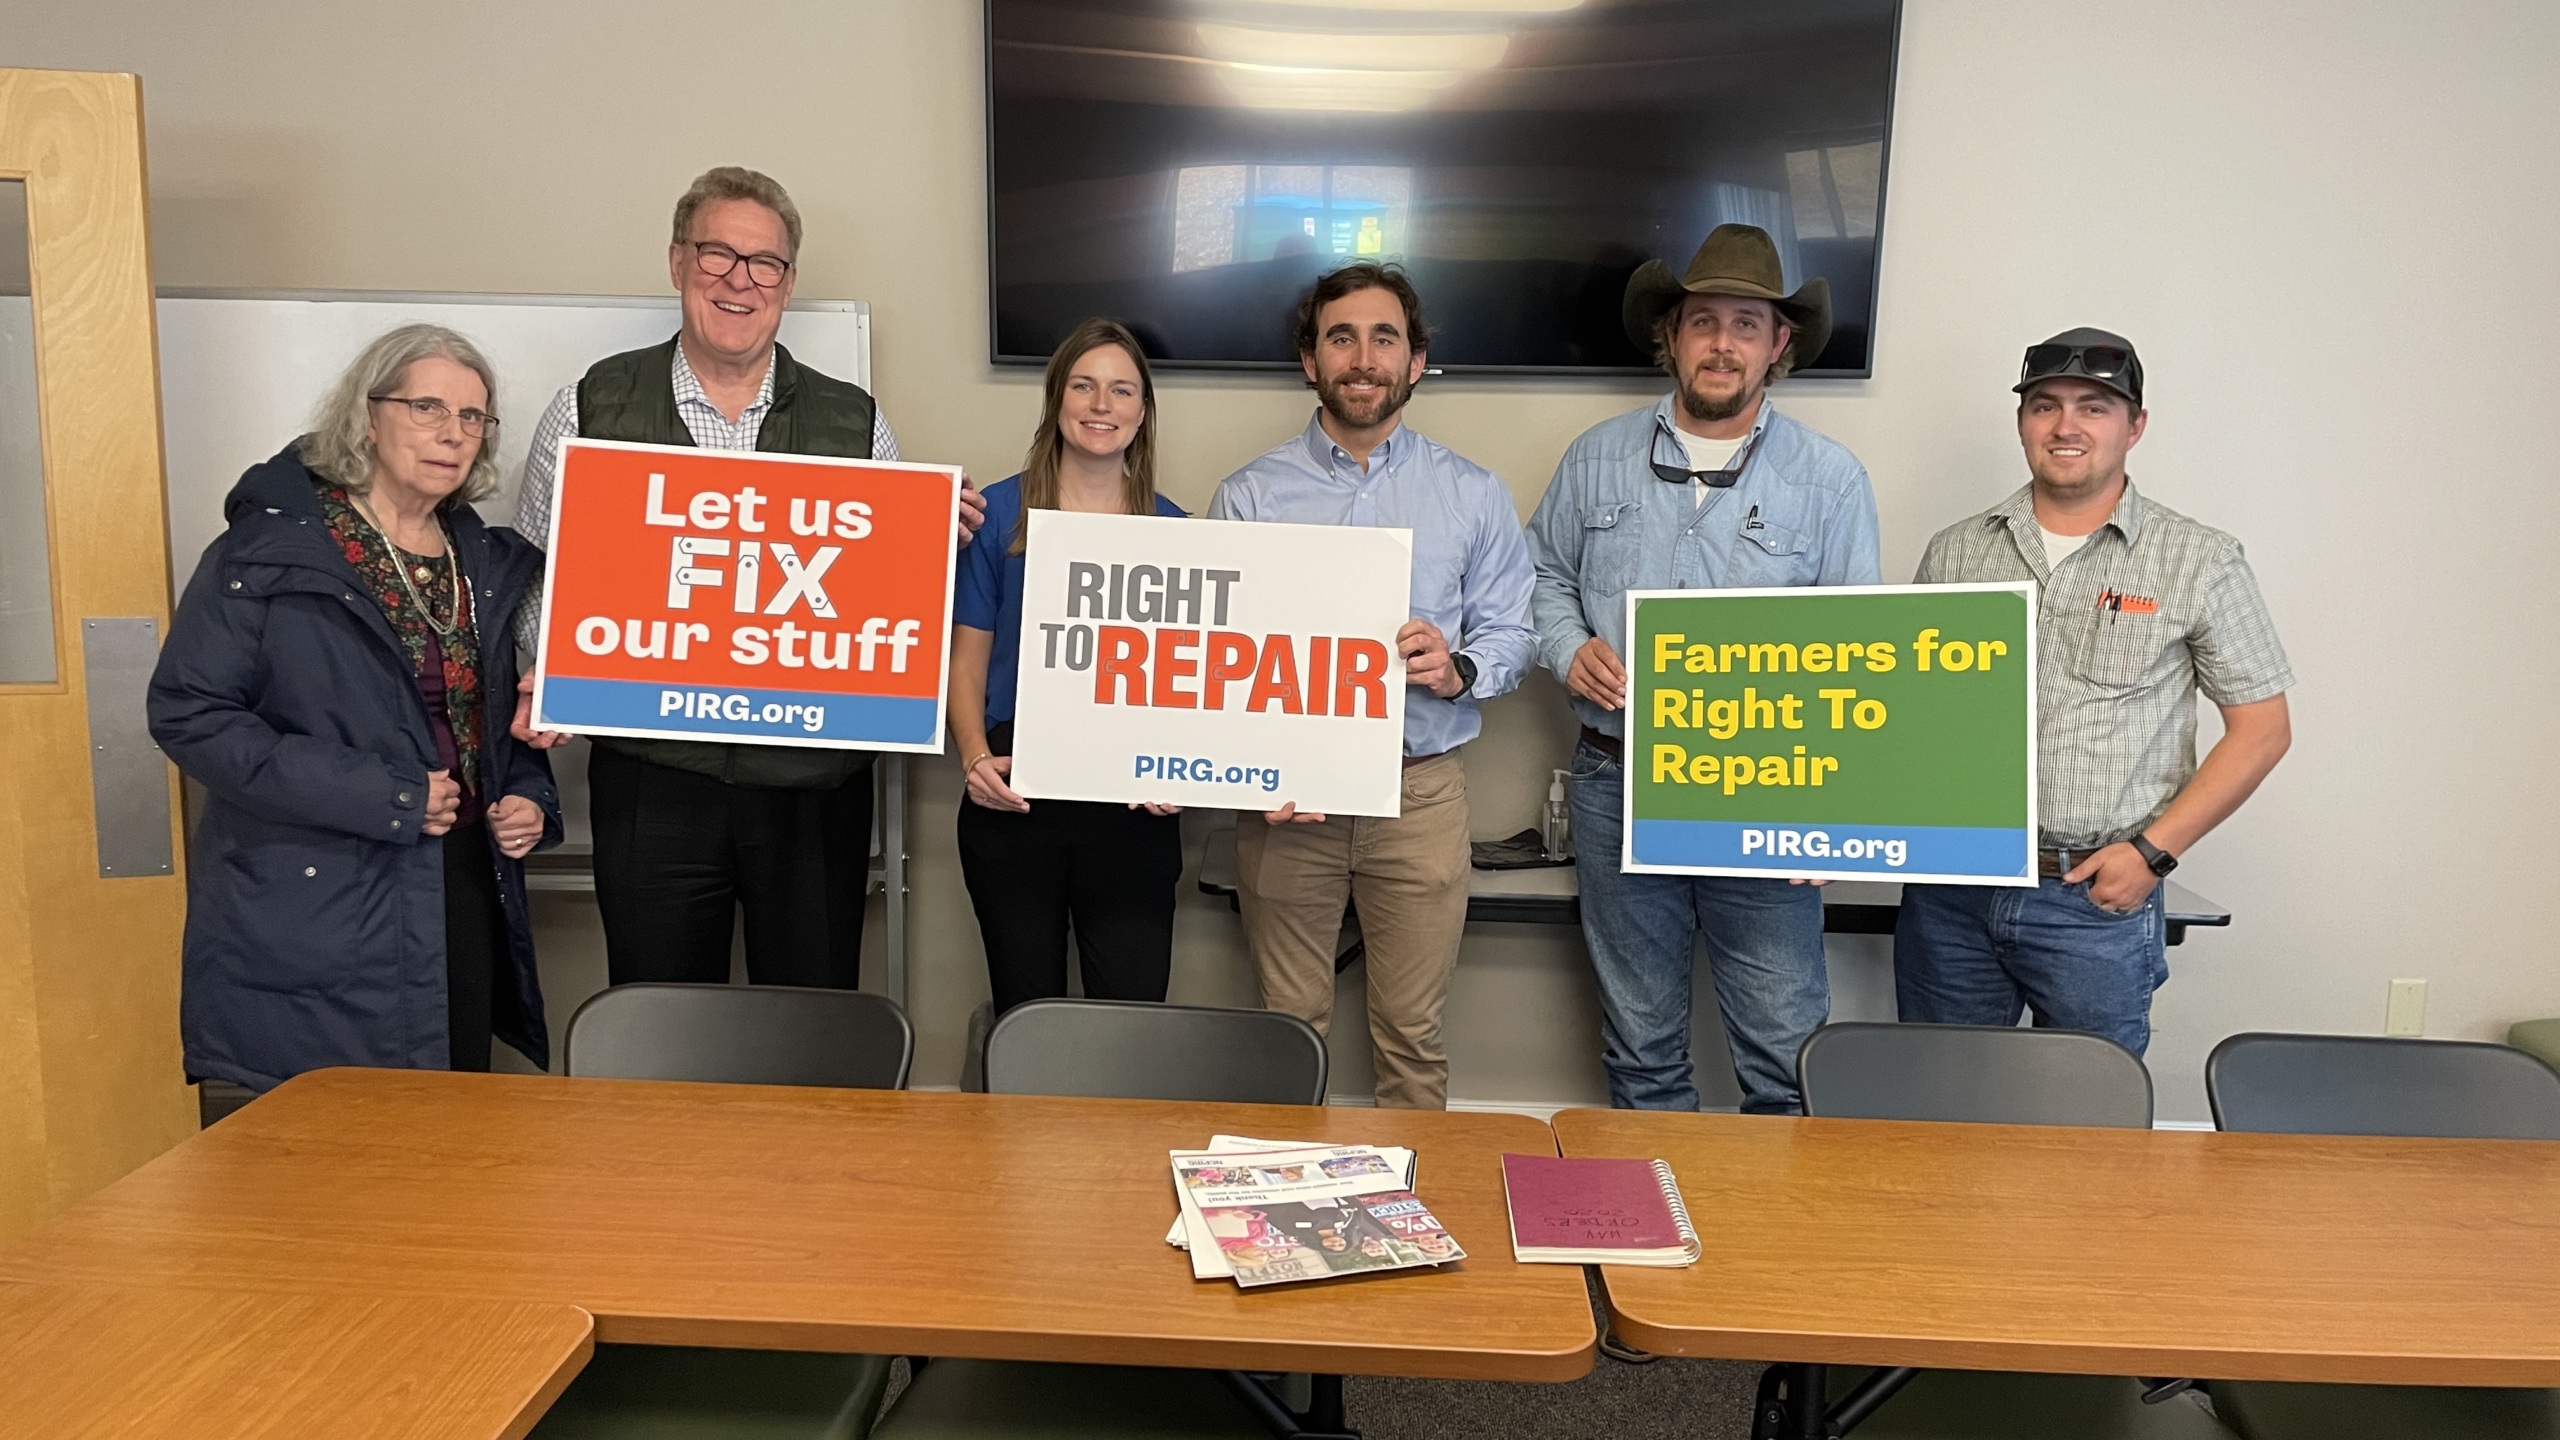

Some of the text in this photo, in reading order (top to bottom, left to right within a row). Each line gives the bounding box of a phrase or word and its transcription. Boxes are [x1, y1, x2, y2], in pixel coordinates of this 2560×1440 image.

[645, 473, 871, 539] Let us
[666, 536, 843, 619] FIX
[1066, 561, 1241, 625] RIGHT
[576, 617, 921, 673] our stuff
[1655, 629, 2007, 673] Farmers for
[1039, 622, 1388, 719] TO REPAIR
[660, 691, 825, 732] PIRG.org
[1654, 688, 1886, 739] Right To
[1134, 755, 1280, 791] PIRG.org
[1653, 745, 1838, 795] Repair
[1742, 829, 1908, 866] PIRG.org
[1234, 1194, 1269, 1202] Thank
[1543, 1216, 1640, 1227] ORDERS
